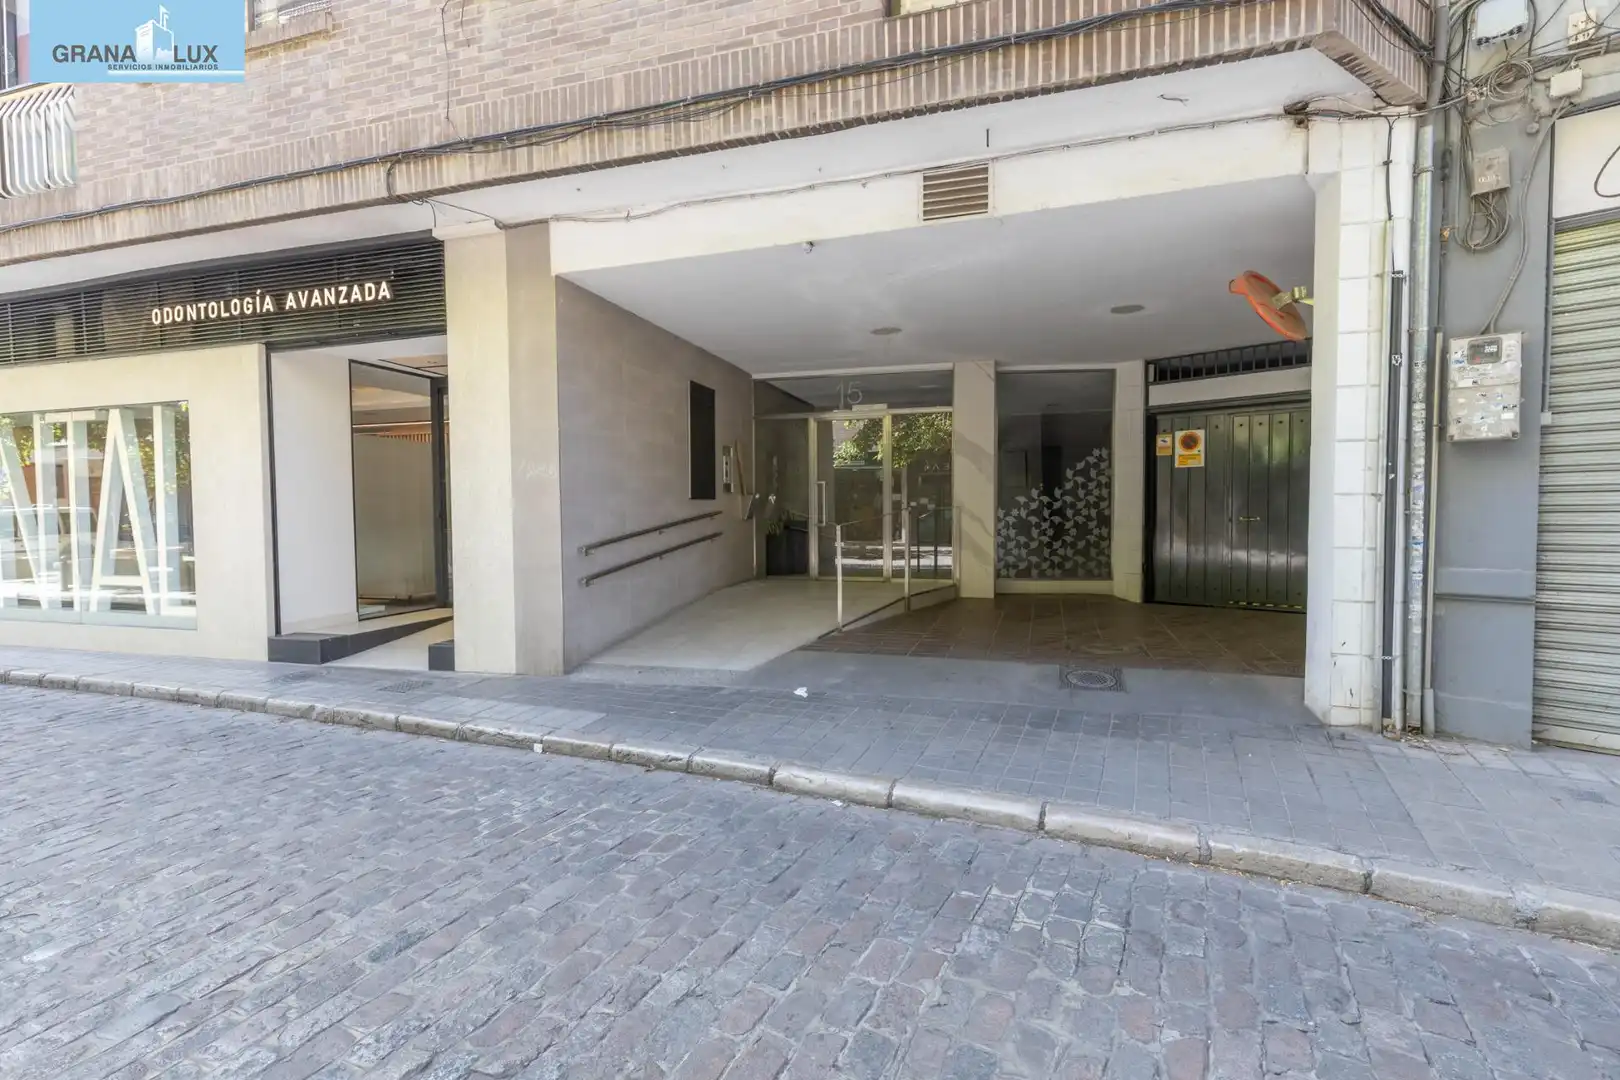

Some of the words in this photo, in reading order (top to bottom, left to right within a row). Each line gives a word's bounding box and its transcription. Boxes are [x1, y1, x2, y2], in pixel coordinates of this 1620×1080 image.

[151, 289, 274, 324] ODONTOLOGÍA
[285, 281, 391, 310] AVANZADA
[836, 379, 863, 409] 15
